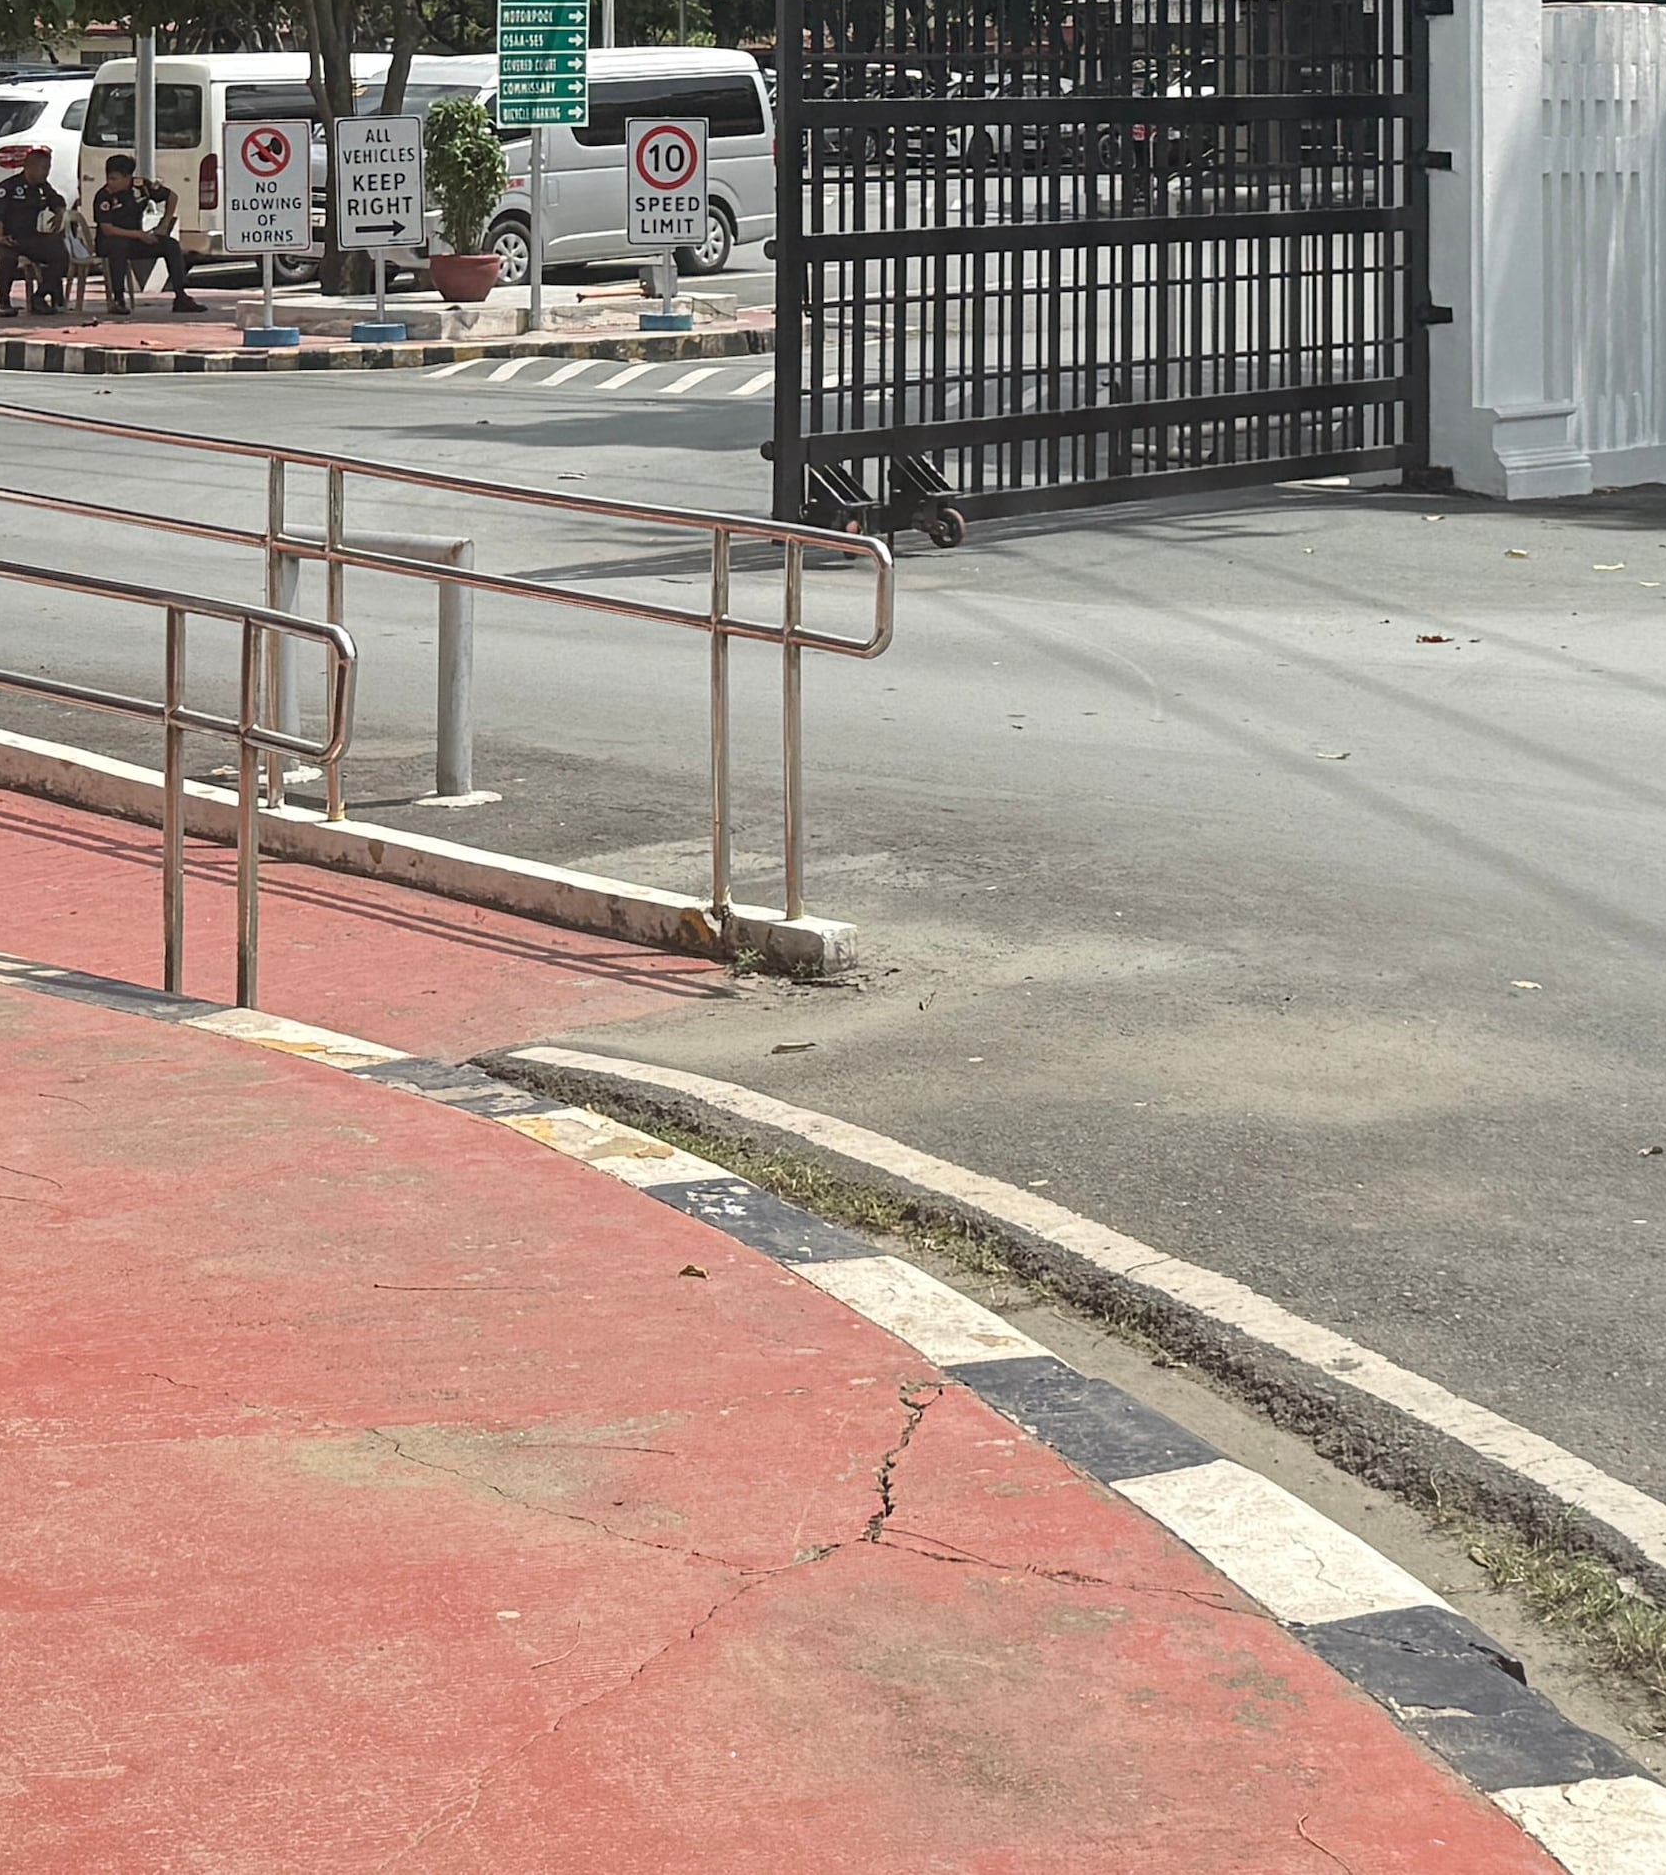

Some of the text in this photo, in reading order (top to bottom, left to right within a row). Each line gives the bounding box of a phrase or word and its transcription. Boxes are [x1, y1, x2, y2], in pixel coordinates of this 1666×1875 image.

[502, 57, 557, 72] COVERED COURT
[502, 80, 556, 96] COMMISSARY
[532, 105, 561, 120] PARKING
[365, 128, 392, 143] ALL
[343, 147, 415, 165] VEHICLES
[648, 143, 685, 173] 10
[255, 180, 278, 194] NO
[352, 172, 406, 192] KEEP
[231, 197, 302, 211] BLOWING
[347, 196, 413, 216] RIGHT
[635, 196, 700, 212] SPEED
[257, 213, 278, 227] OF
[641, 218, 694, 234] LIMIT
[241, 229, 294, 243] HORNS
